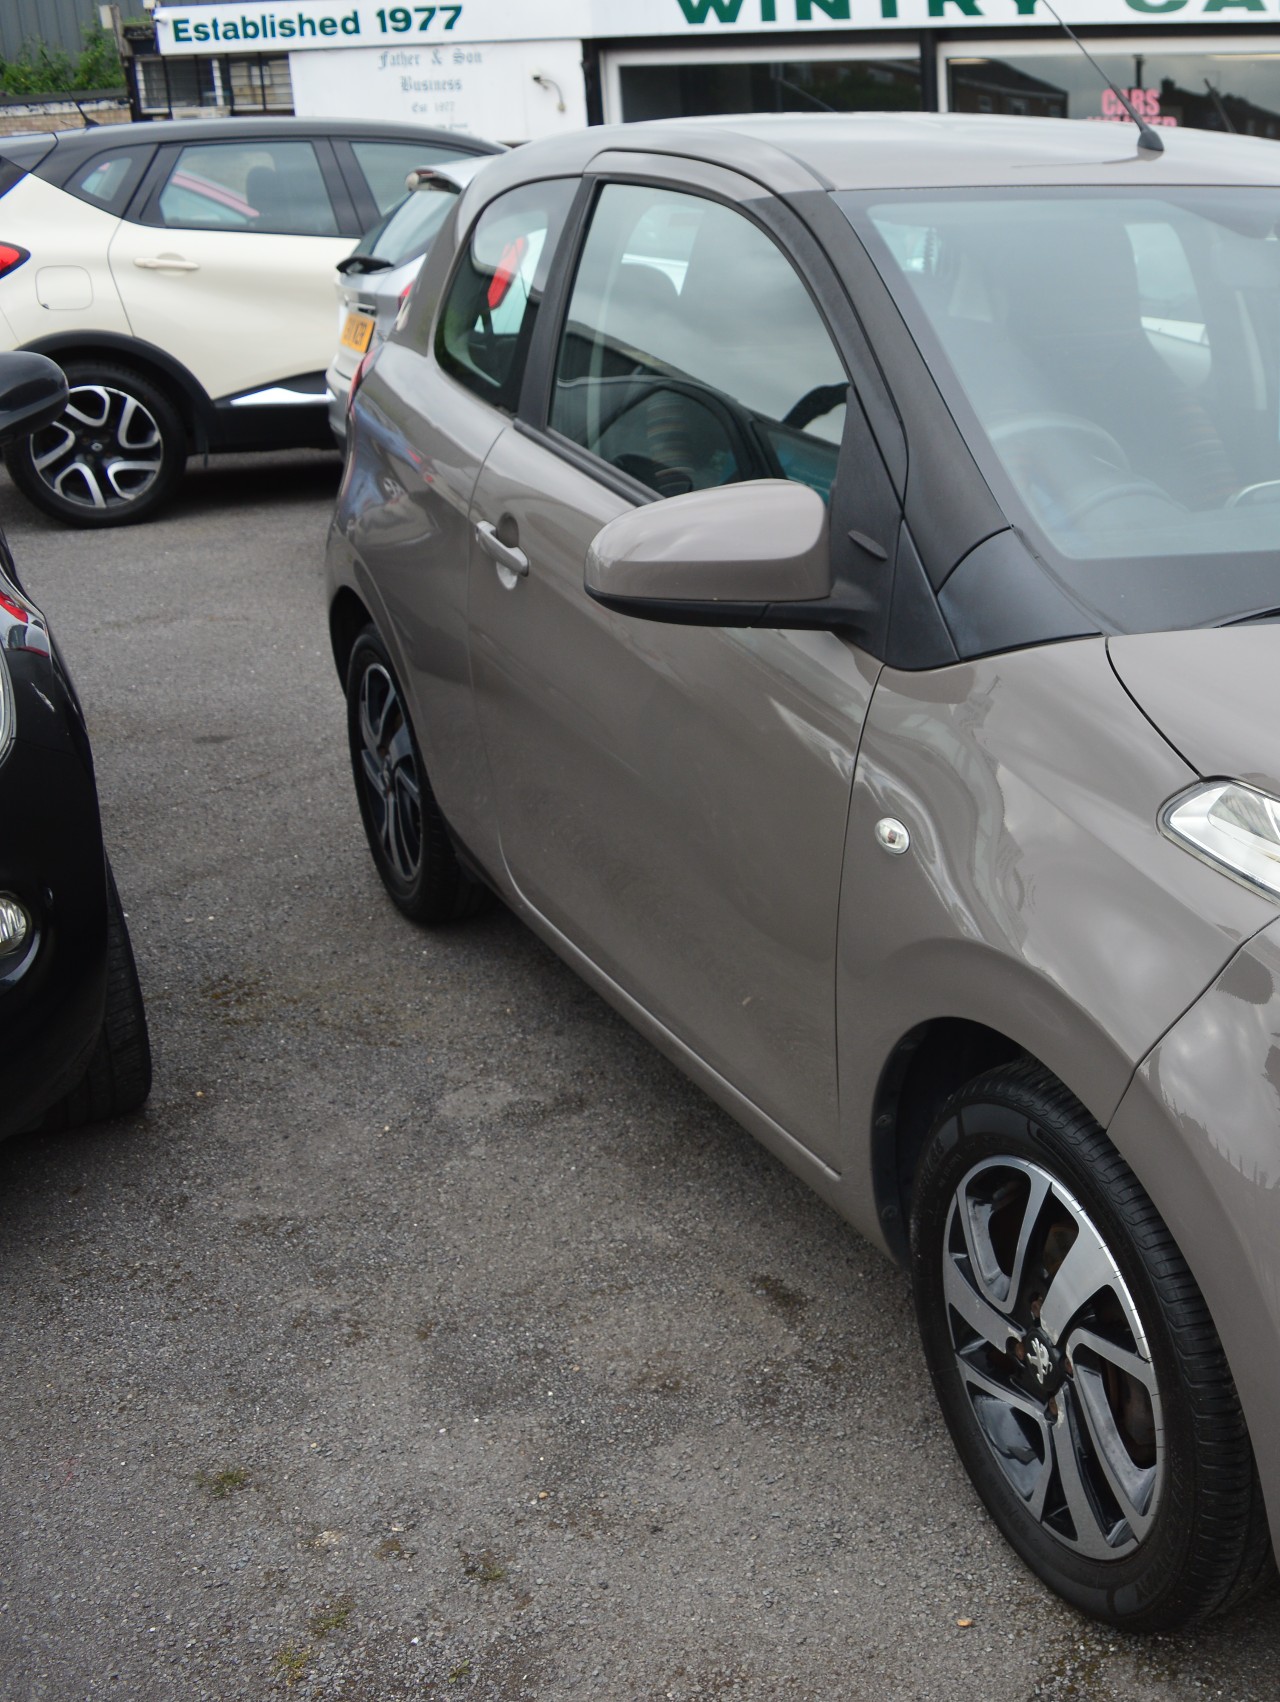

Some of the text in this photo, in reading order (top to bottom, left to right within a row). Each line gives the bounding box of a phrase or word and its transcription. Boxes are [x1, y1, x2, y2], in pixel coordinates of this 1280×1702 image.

[171, 5, 463, 43] Established 1977
[378, 48, 483, 69] Father & Son
[400, 75, 463, 92] Business
